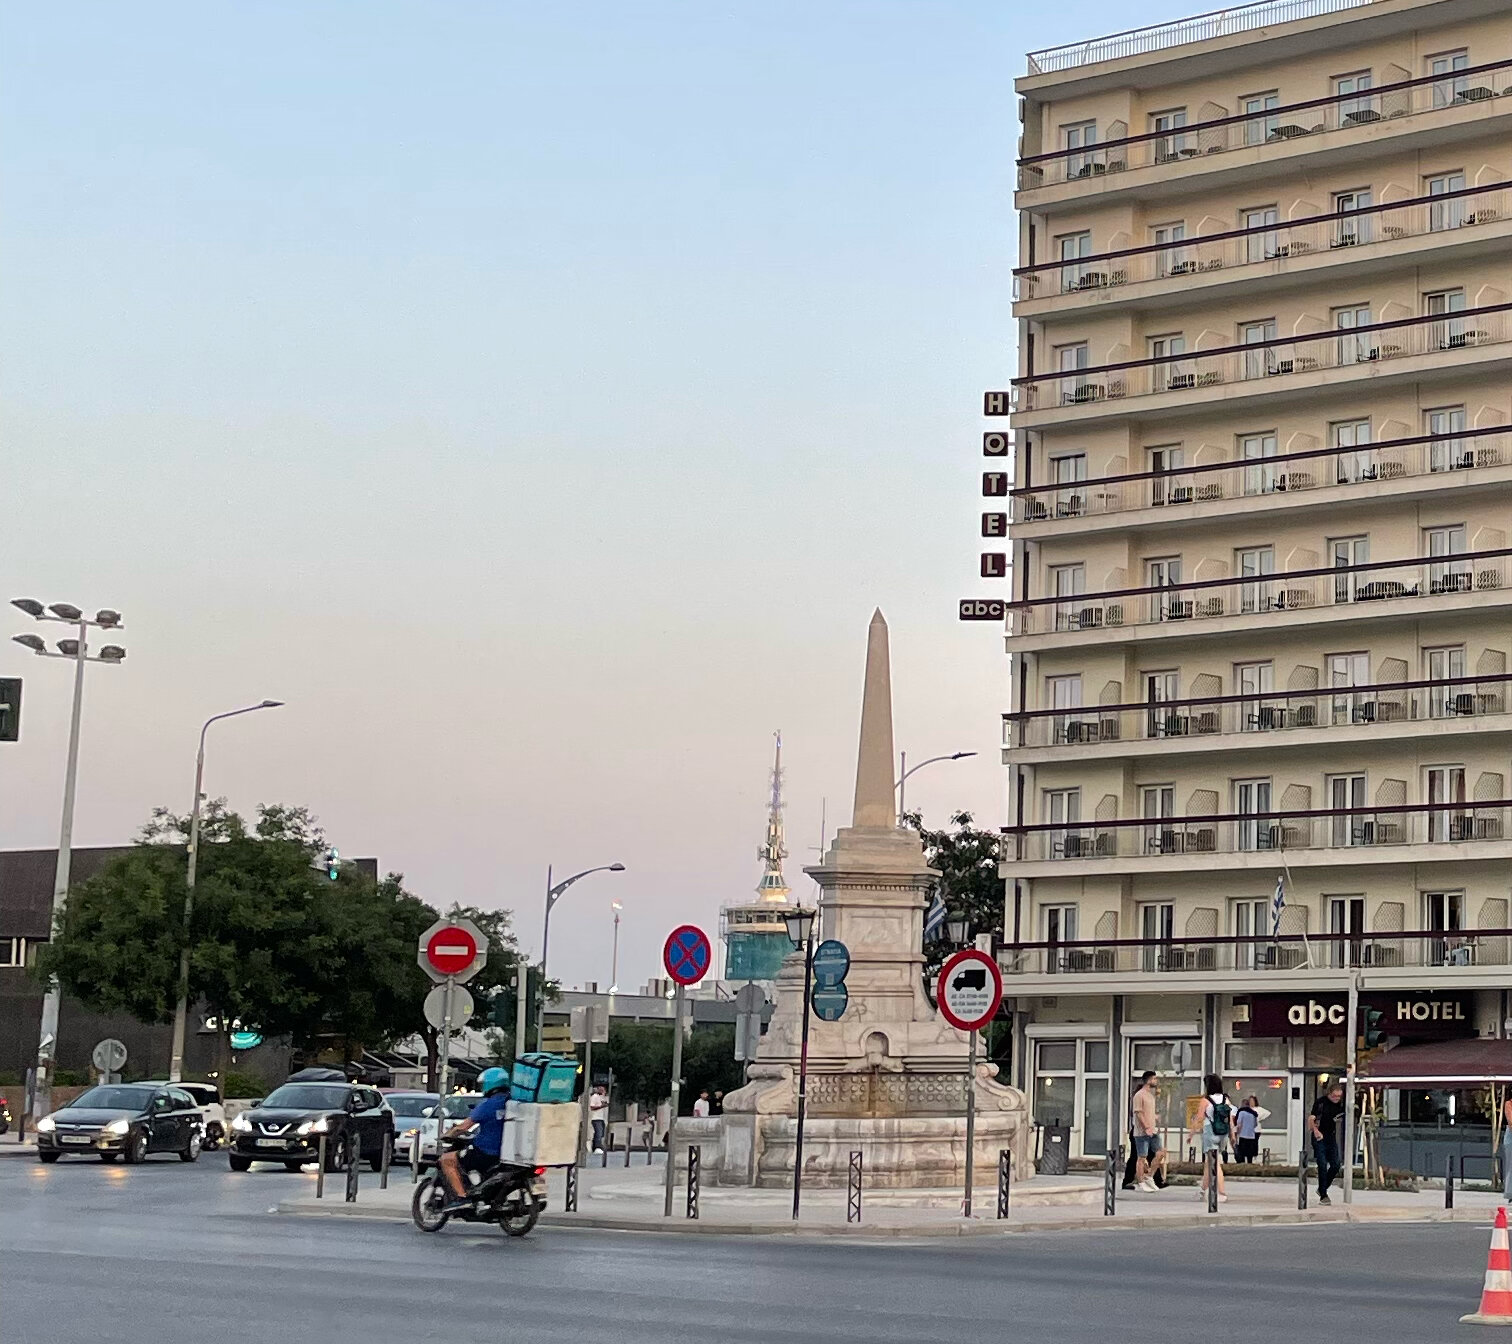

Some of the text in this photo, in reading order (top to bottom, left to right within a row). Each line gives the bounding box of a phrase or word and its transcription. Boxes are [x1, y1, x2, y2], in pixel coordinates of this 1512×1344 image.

[984, 392, 1006, 575] HOTEL
[960, 600, 1002, 617] abc
[1288, 999, 1465, 1025] abc HOTEL
